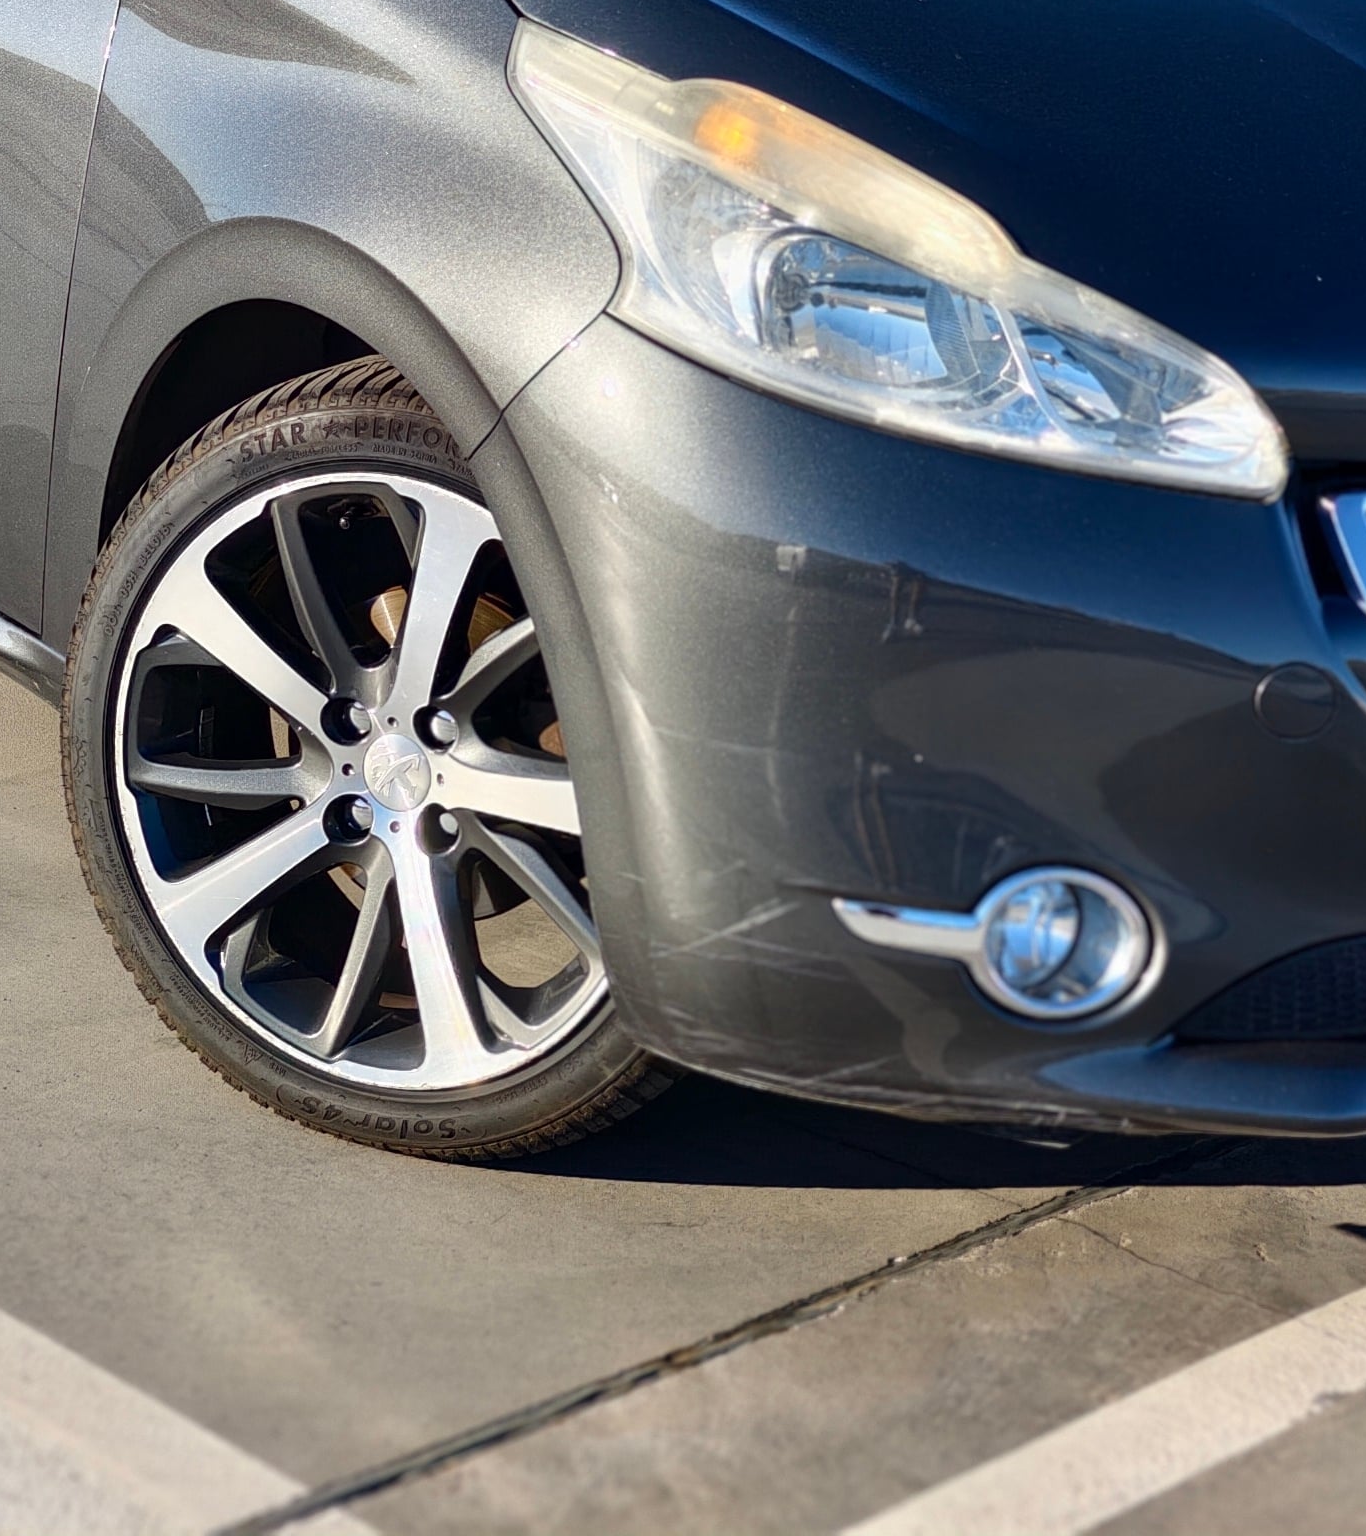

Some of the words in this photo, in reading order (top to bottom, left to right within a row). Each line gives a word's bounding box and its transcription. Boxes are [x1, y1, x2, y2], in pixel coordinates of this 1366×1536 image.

[238, 421, 307, 463] STAR
[299, 1095, 343, 1122] 4S
[356, 1113, 457, 1140] Solar
